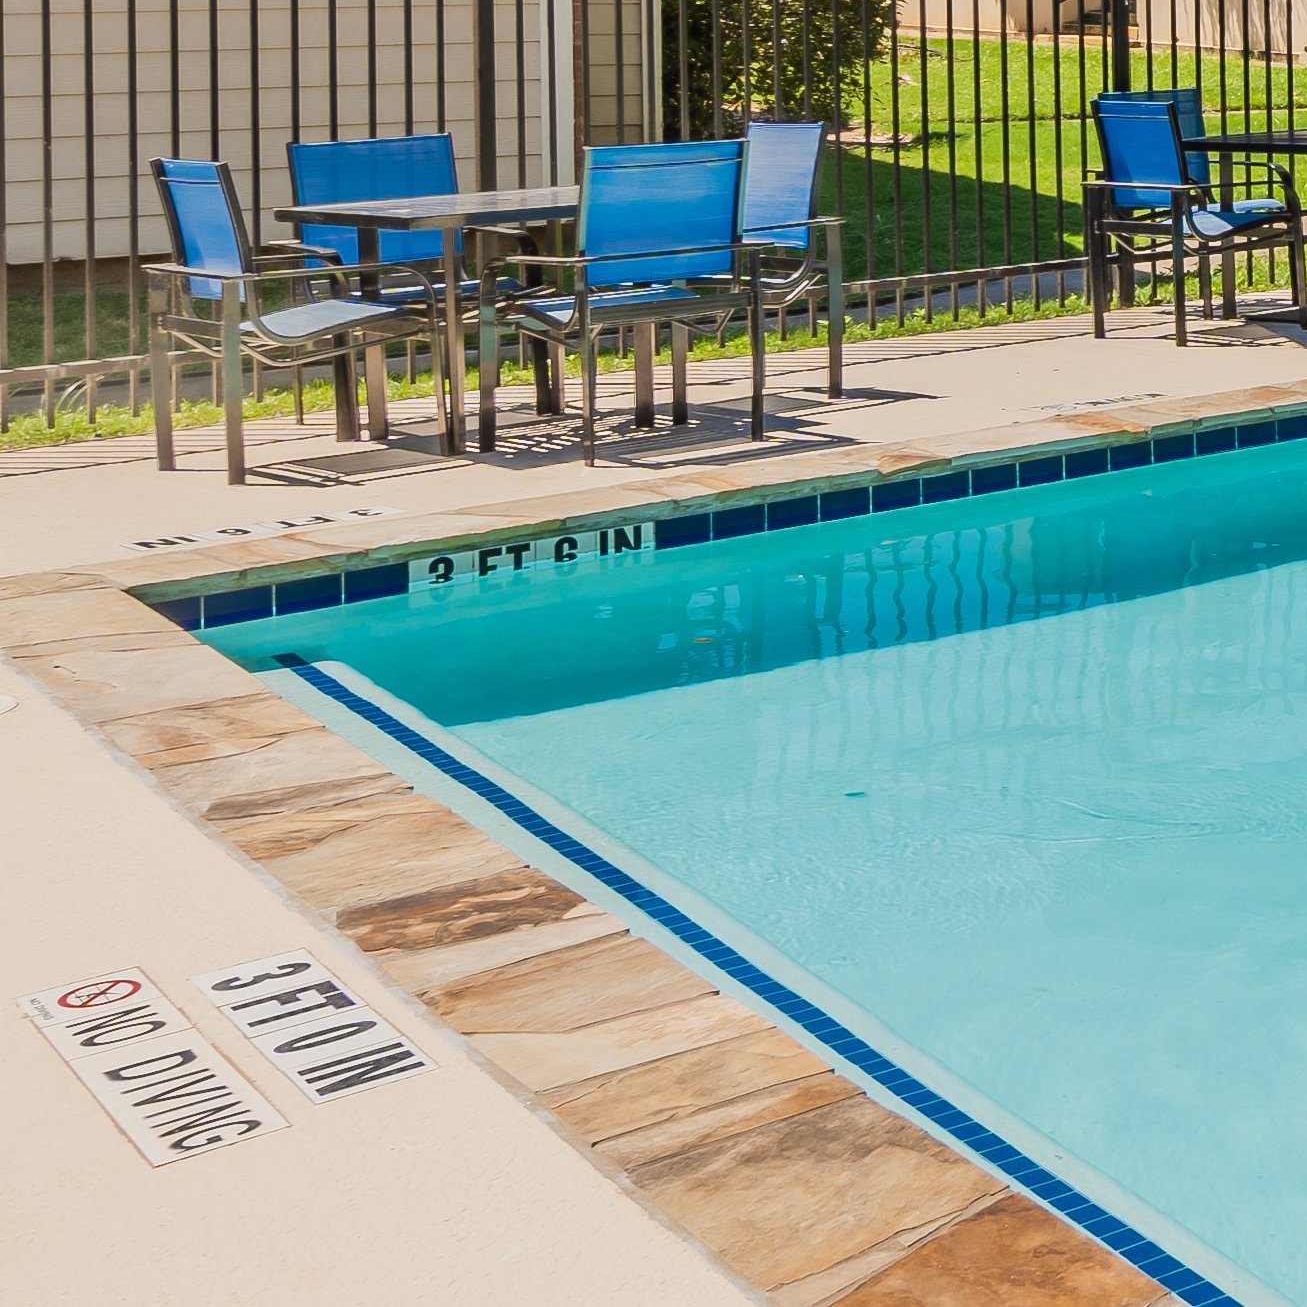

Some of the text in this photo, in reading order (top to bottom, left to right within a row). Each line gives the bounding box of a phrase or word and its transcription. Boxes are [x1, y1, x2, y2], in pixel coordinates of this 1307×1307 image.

[215, 527, 253, 536] 6
[276, 515, 338, 530] FT
[131, 535, 200, 550] IN
[428, 524, 642, 585] 3 FT 6 IN
[210, 961, 312, 992] 3
[229, 980, 357, 1028] FT
[65, 1004, 263, 1154] NO DIVING
[296, 1041, 427, 1097] IN
